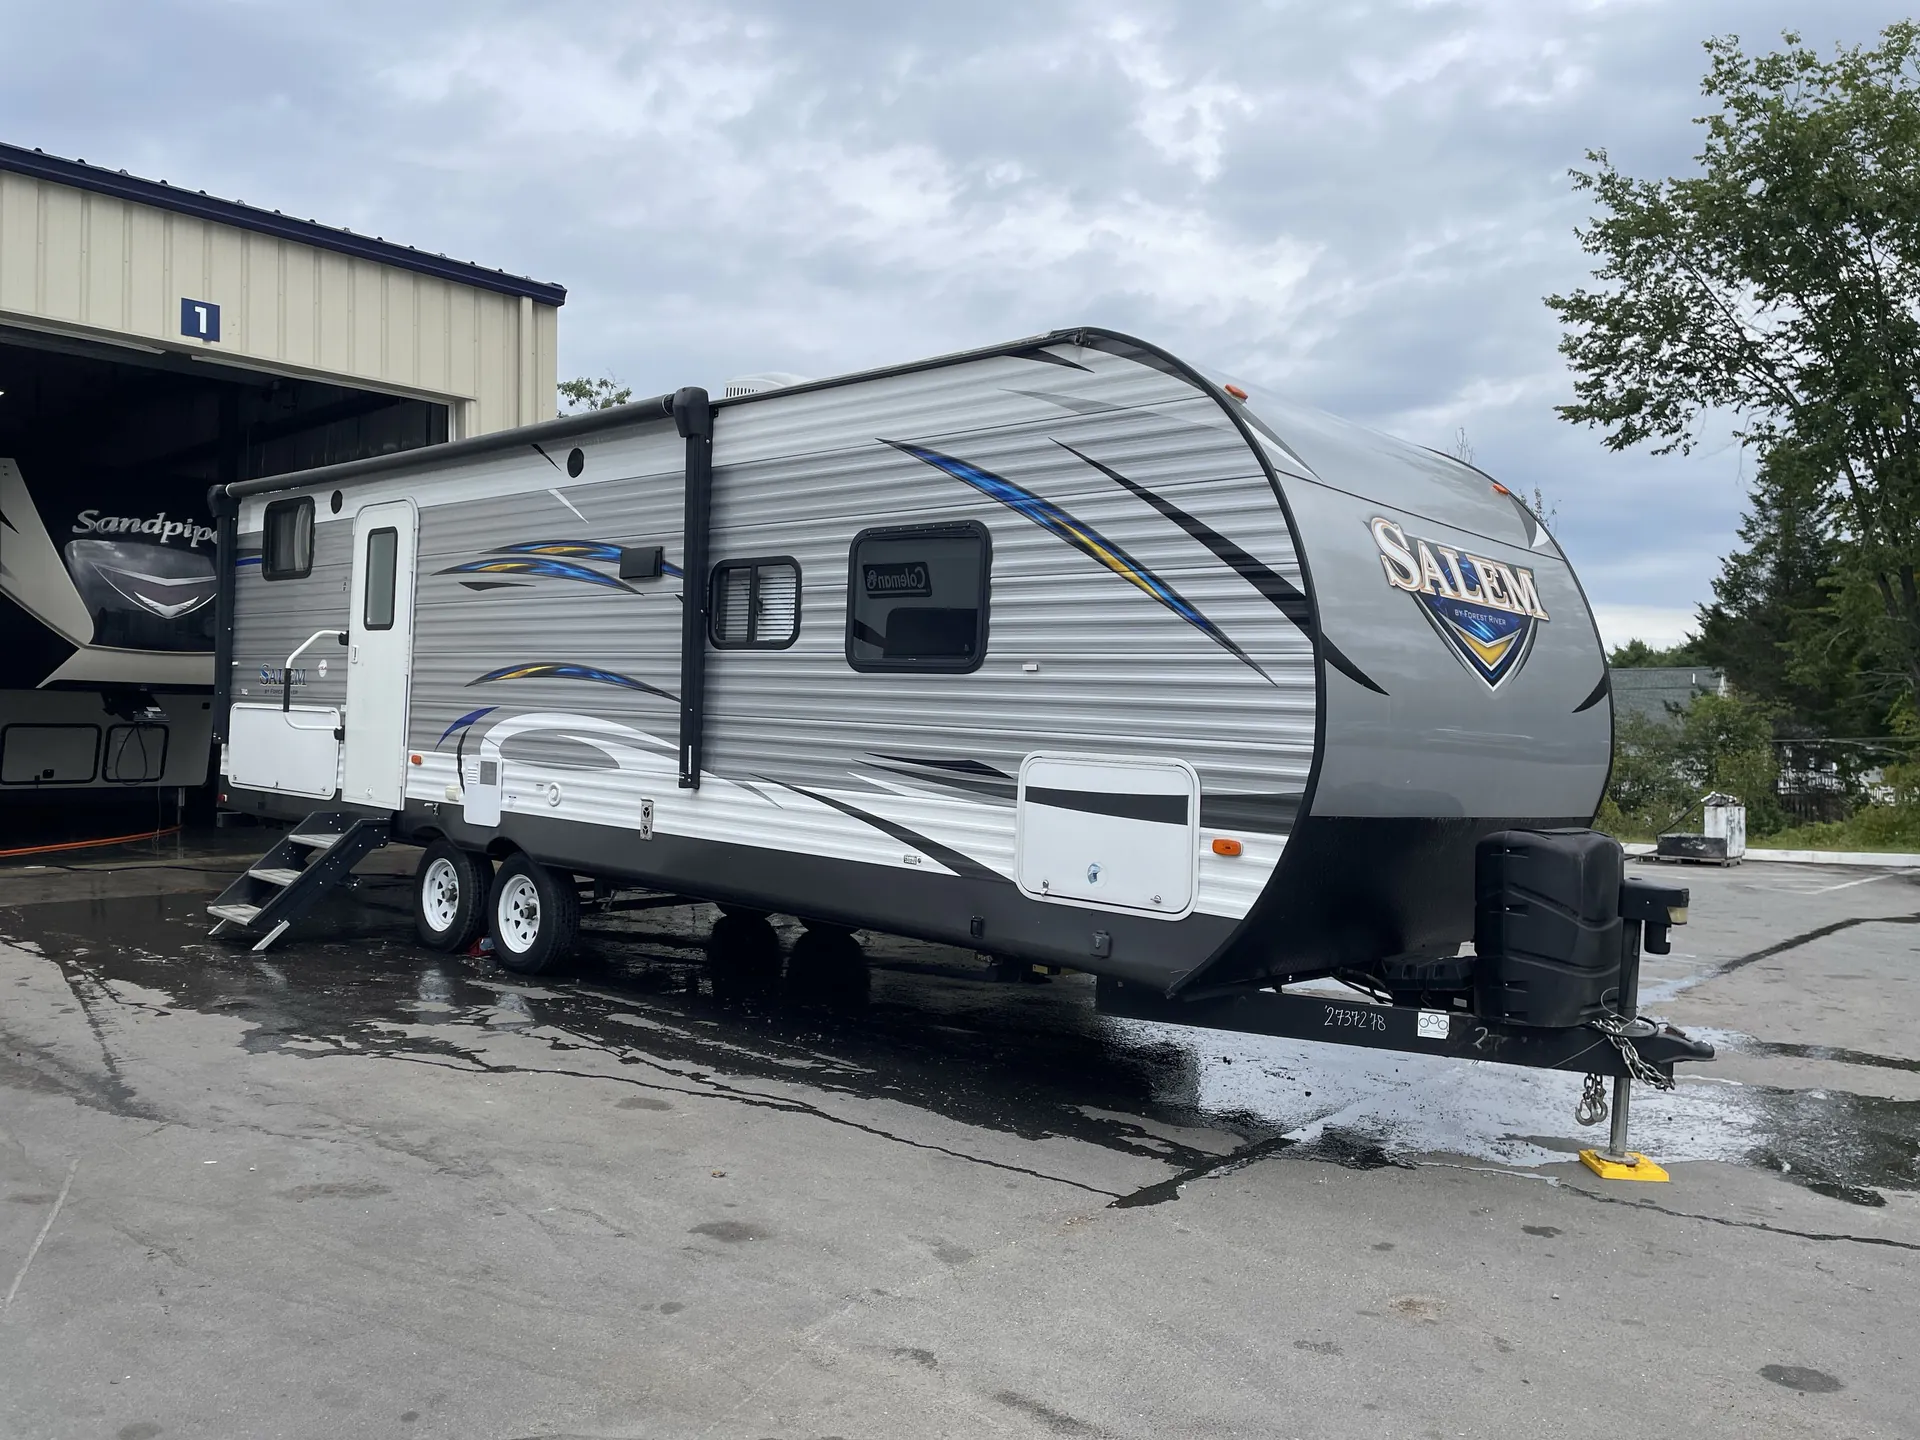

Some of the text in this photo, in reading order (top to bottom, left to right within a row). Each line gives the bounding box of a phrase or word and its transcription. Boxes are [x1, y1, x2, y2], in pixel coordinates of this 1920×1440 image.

[195, 306, 207, 334] 1
[1371, 517, 1551, 622] SALEM
[1464, 609, 1487, 622] FOREST
[1488, 615, 1506, 626] RIVER
[1324, 1007, 1387, 1031] 2737278
